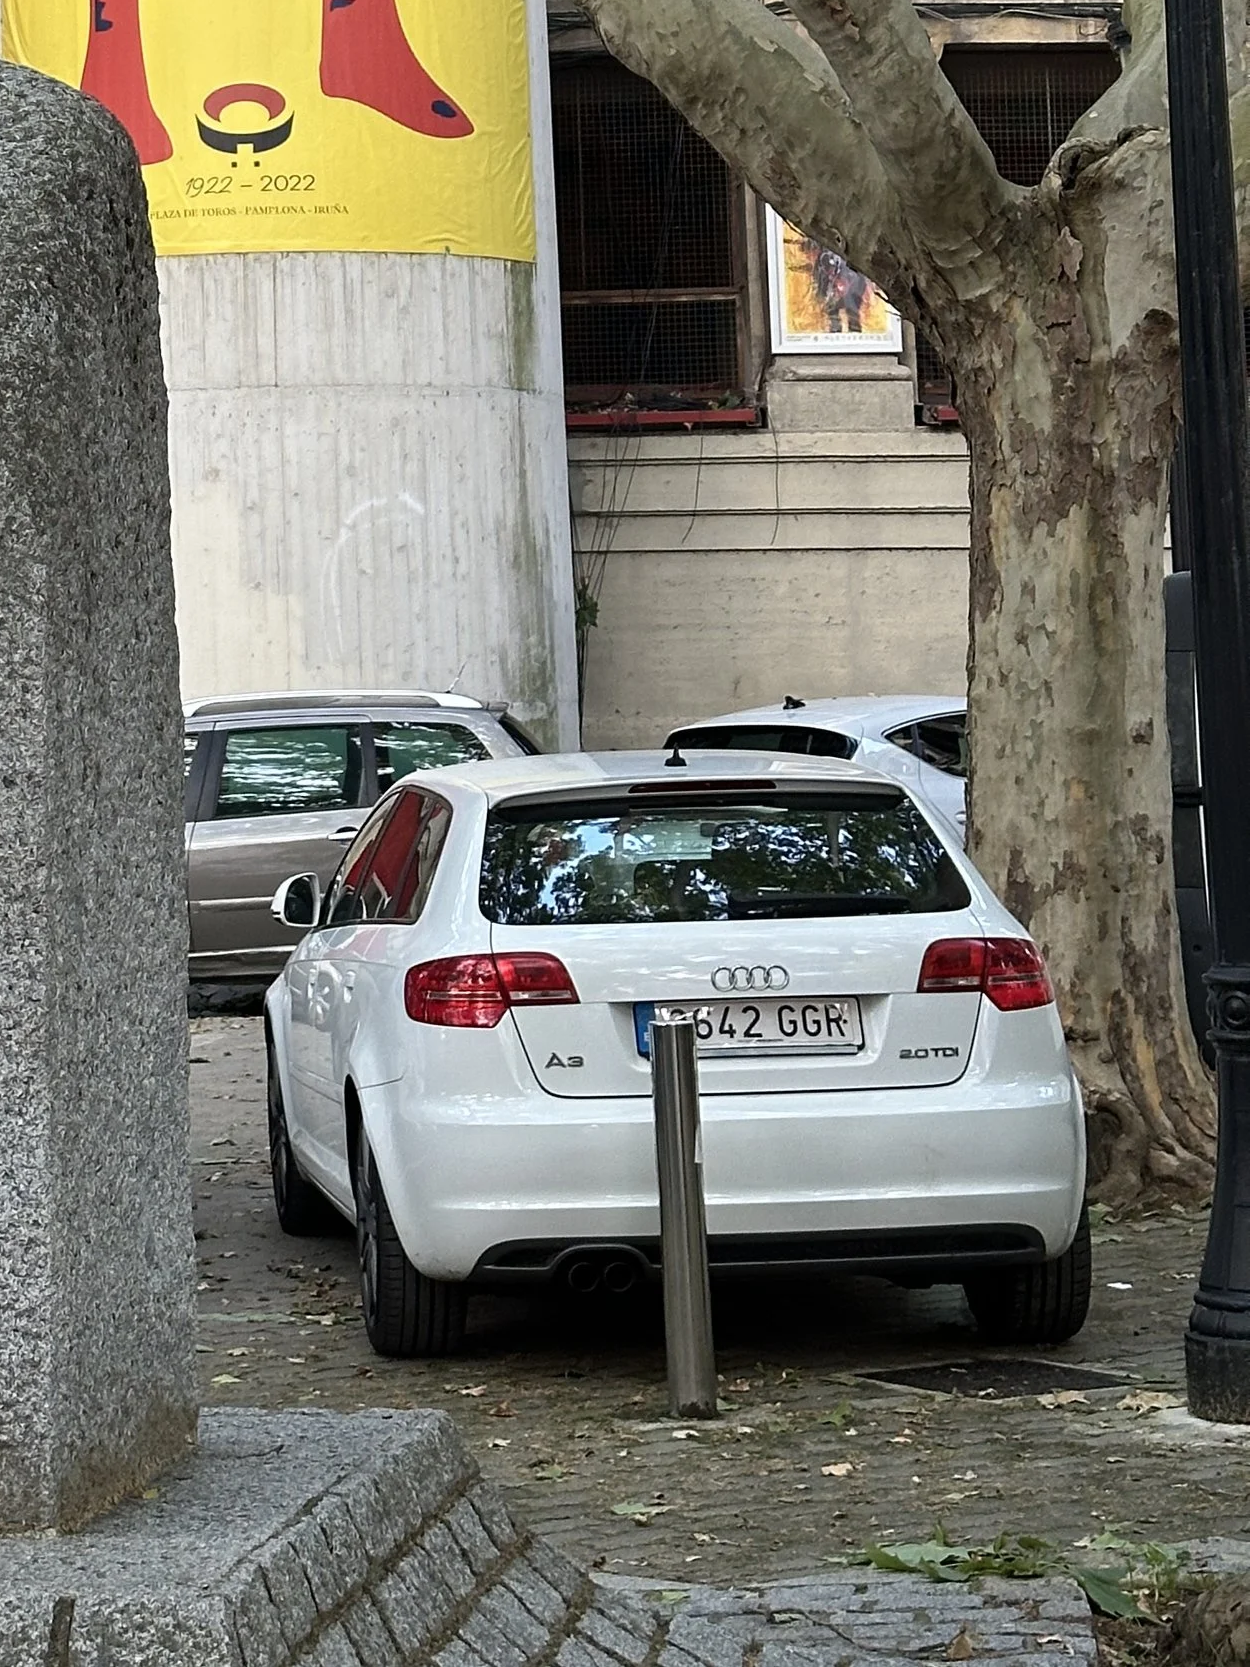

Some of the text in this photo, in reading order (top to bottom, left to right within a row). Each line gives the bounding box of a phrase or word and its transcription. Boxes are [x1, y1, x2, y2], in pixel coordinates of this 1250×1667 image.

[184, 175, 234, 198] 1922
[259, 174, 316, 192] 2022
[150, 210, 181, 220] PLAZA
[183, 209, 198, 218] DE
[201, 207, 237, 217] TOROS
[244, 205, 307, 216] PAMPLONA
[314, 202, 350, 215] IRUÑA
[777, 1003, 846, 1037] GGR
[545, 1052, 584, 1069] A3
[930, 1046, 959, 1058] TDI
